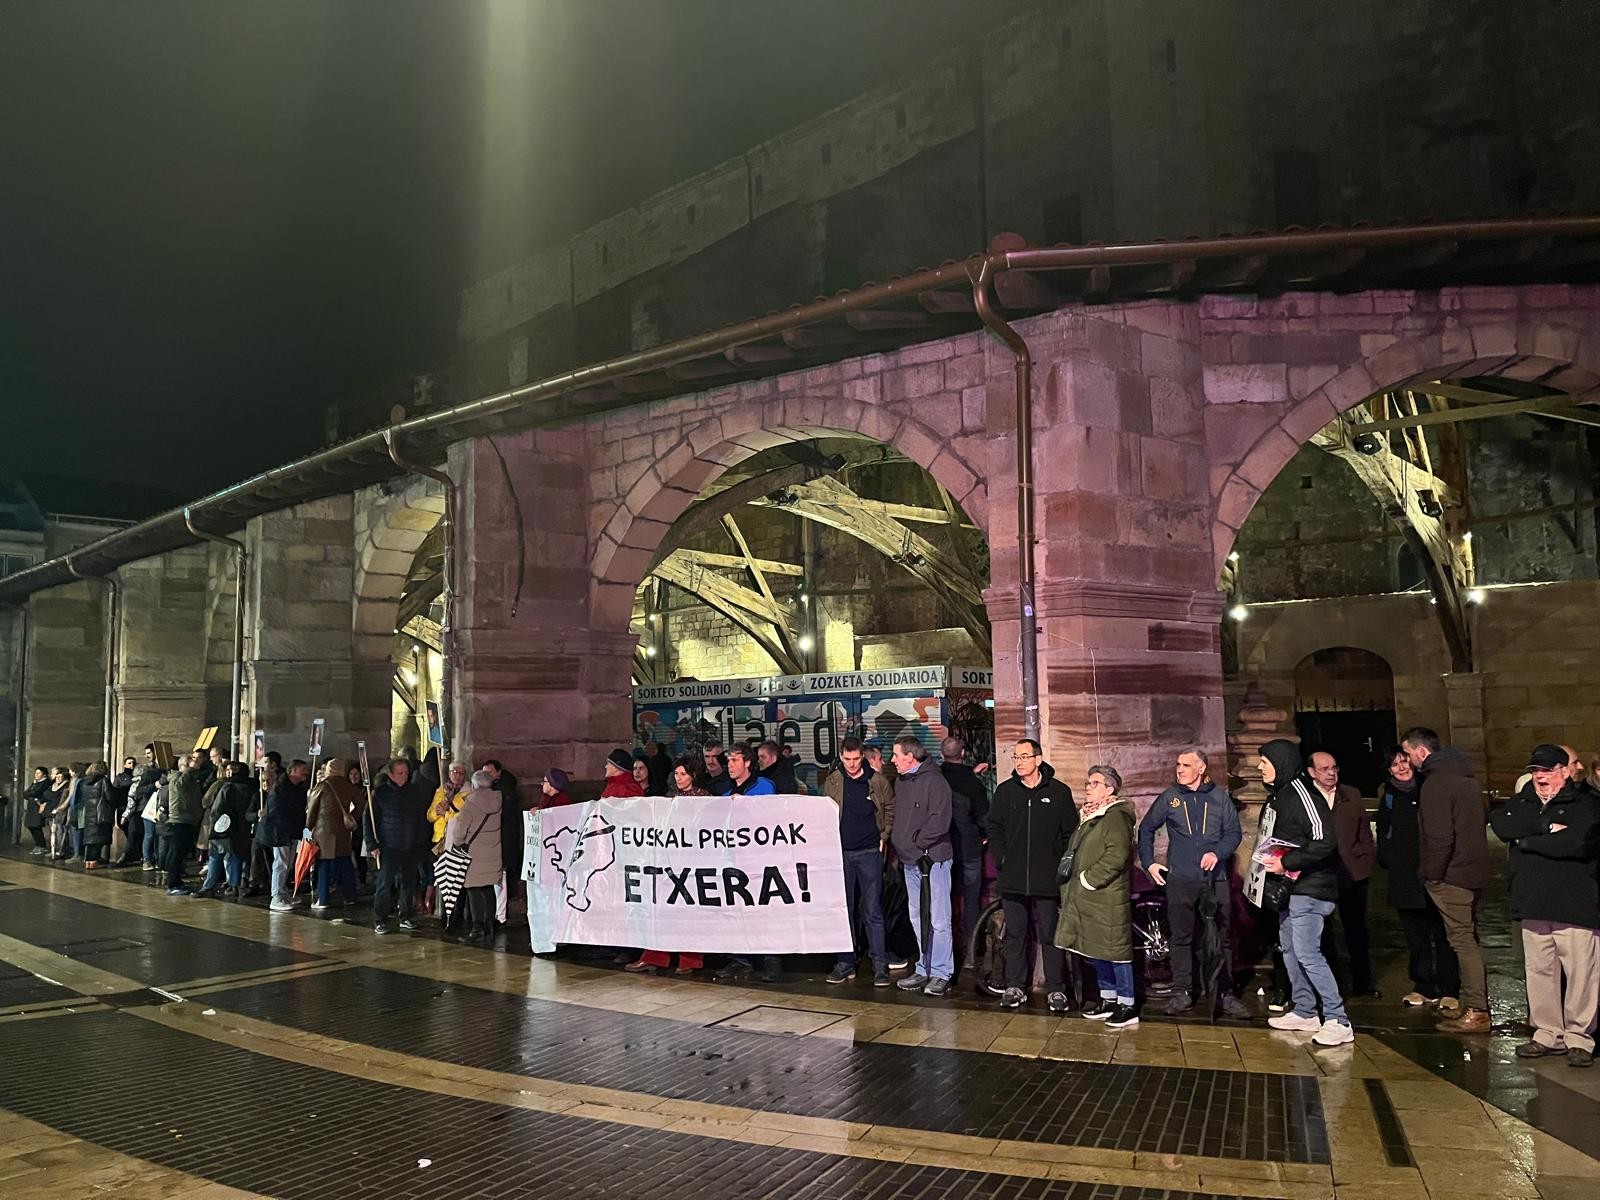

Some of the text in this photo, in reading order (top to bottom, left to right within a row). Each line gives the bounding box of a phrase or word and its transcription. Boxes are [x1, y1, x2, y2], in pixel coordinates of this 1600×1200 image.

[638, 683, 731, 699] SORTEO SOLIDARIO
[810, 670, 938, 690] ZOZKETA SOLIDARIOA
[621, 823, 807, 849] EUSKAL PRESOAK
[624, 862, 811, 907] ETXERA!
